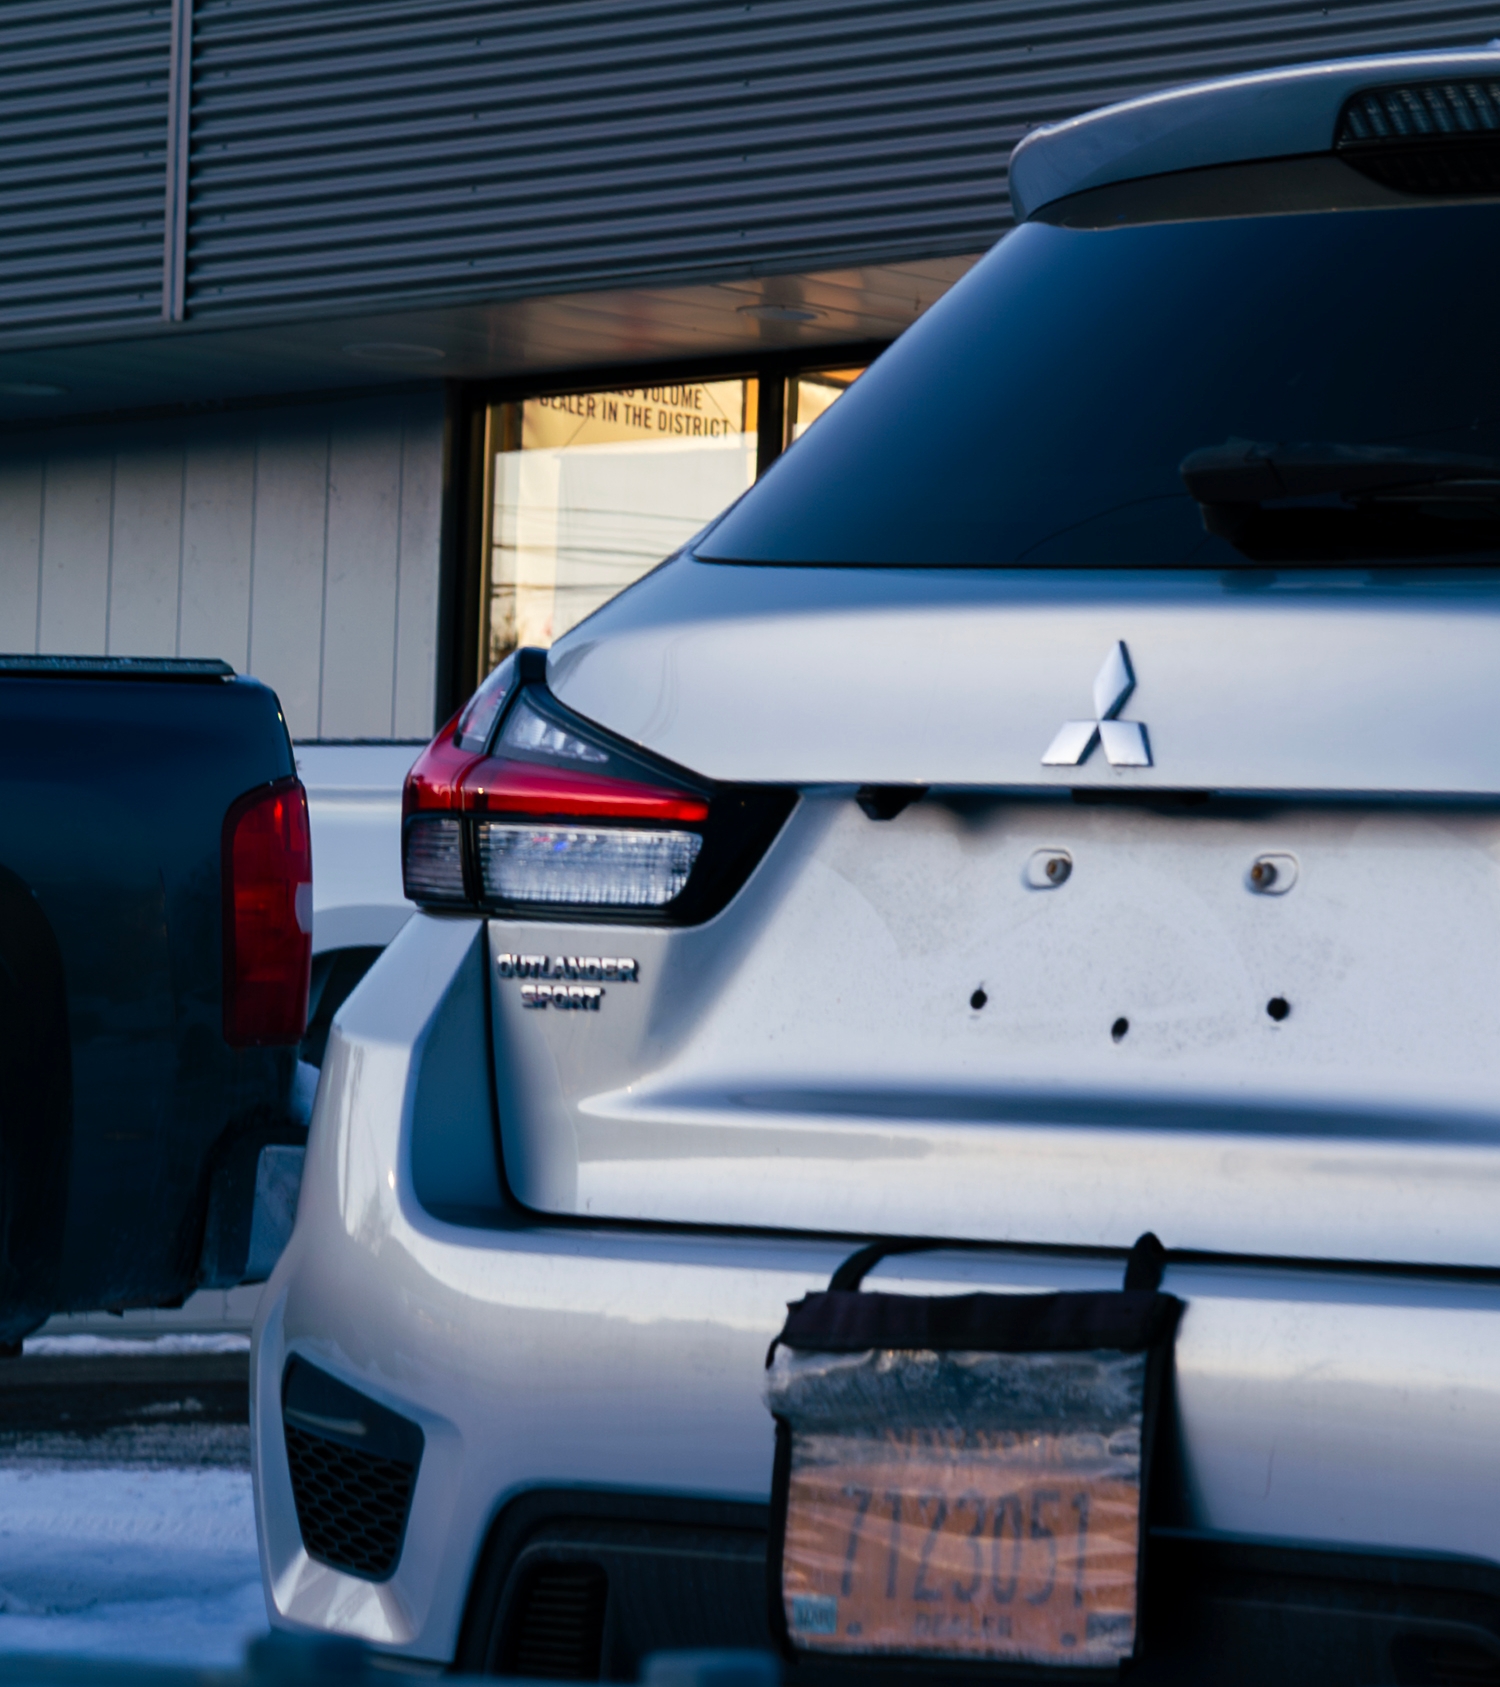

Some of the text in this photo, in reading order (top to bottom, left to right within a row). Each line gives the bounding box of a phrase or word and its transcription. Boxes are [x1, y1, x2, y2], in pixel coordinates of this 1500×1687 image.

[642, 385, 703, 410] VOLUME
[602, 397, 619, 423] IN
[625, 404, 652, 430] THE
[658, 410, 730, 440] DISTRICT
[496, 953, 639, 983] OUTLANDER
[520, 984, 603, 1011] SPORT
